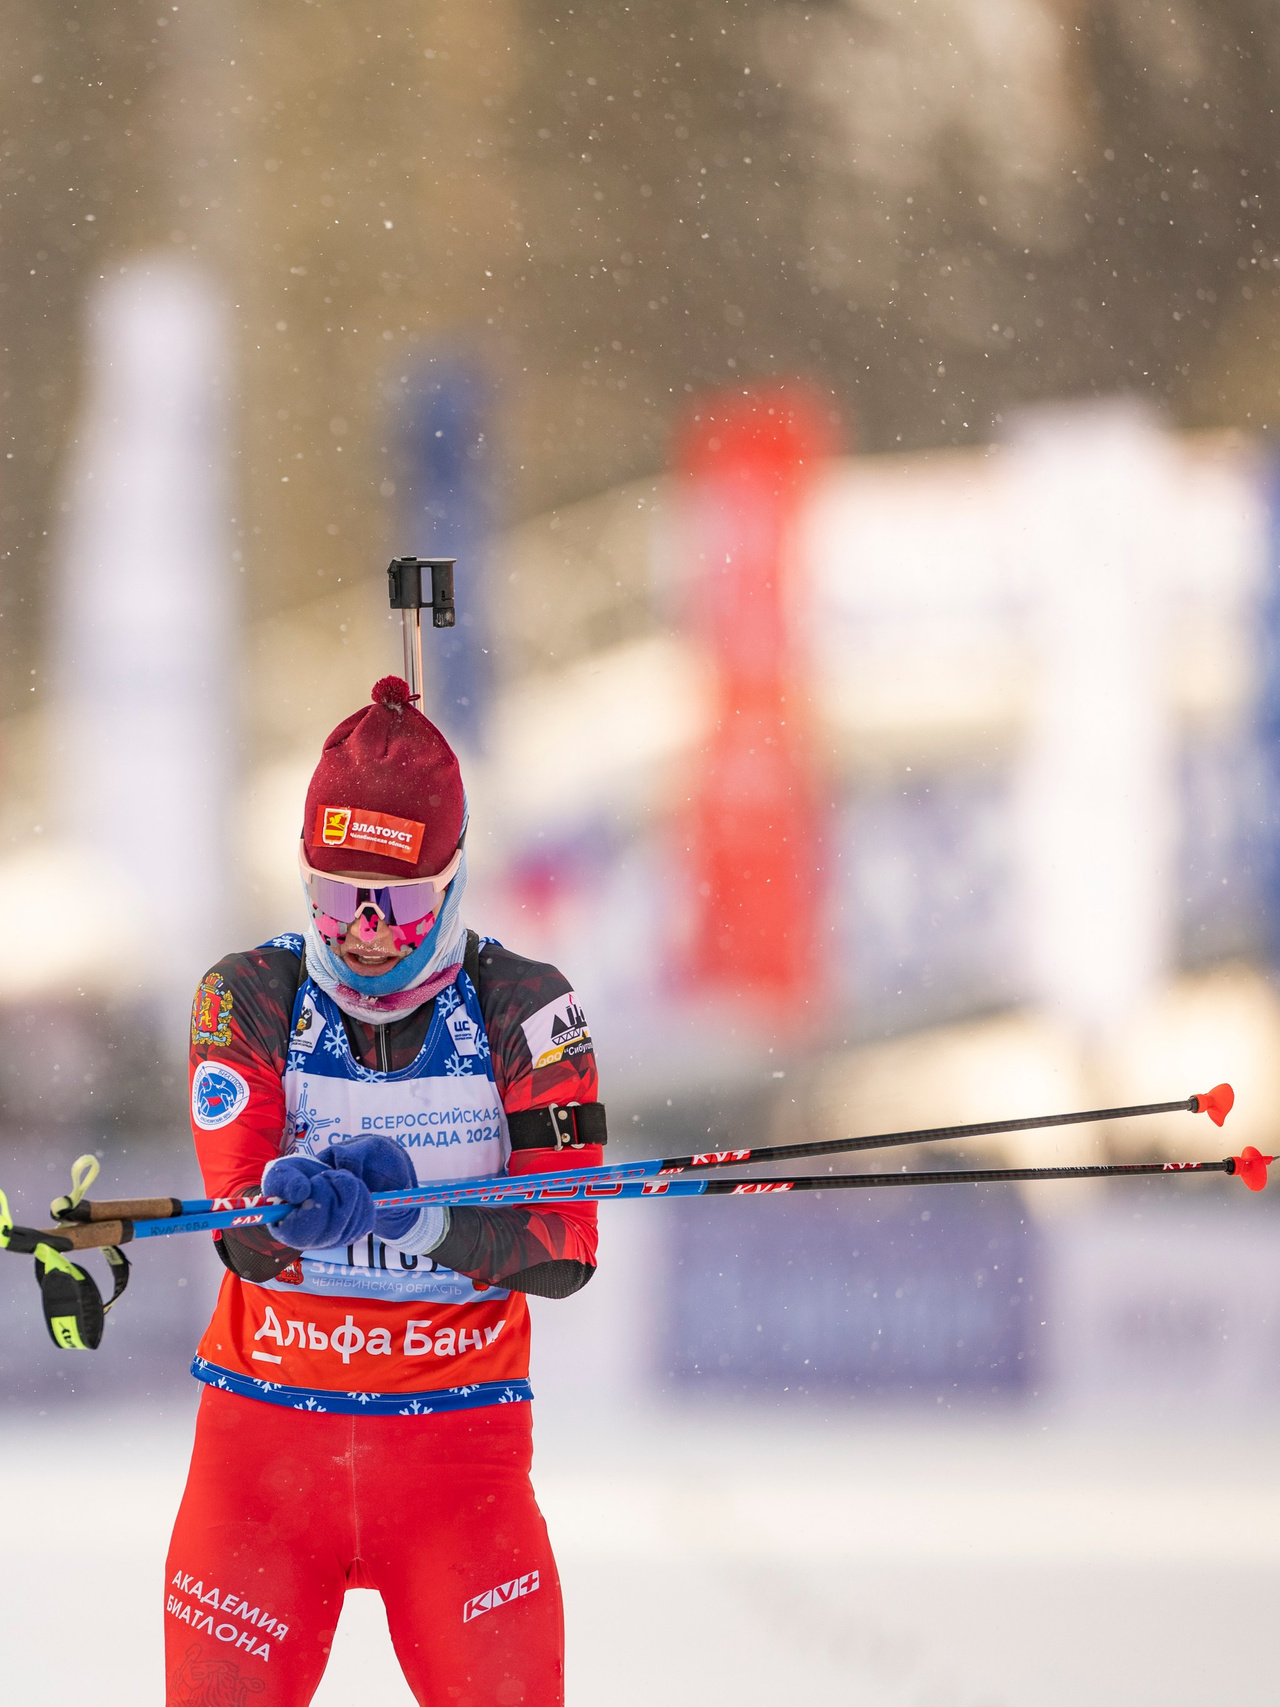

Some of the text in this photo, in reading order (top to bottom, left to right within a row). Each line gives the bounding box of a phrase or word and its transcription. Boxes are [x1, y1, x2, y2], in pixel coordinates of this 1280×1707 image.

[350, 832, 411, 850] Челябинская область
[351, 822, 413, 842] ЗЛАТОУСТ
[538, 1051, 562, 1067] ООО
[361, 1107, 500, 1130] ВСЕРОССИЙСКАЯ
[327, 1125, 501, 1148] СПКИАДА 2024
[691, 1149, 751, 1166] KV+
[729, 1182, 795, 1195] KV+
[231, 1214, 264, 1226] KV+
[312, 1277, 462, 1296] ЧЕЛЯБИНСКАЯ ОБЛАСТЬ
[253, 1306, 507, 1364] Альфа Банк
[172, 1569, 290, 1641] АКАДЕМИЯ
[463, 1570, 540, 1623] KV+
[166, 1594, 271, 1663] БИАТЛОНА
